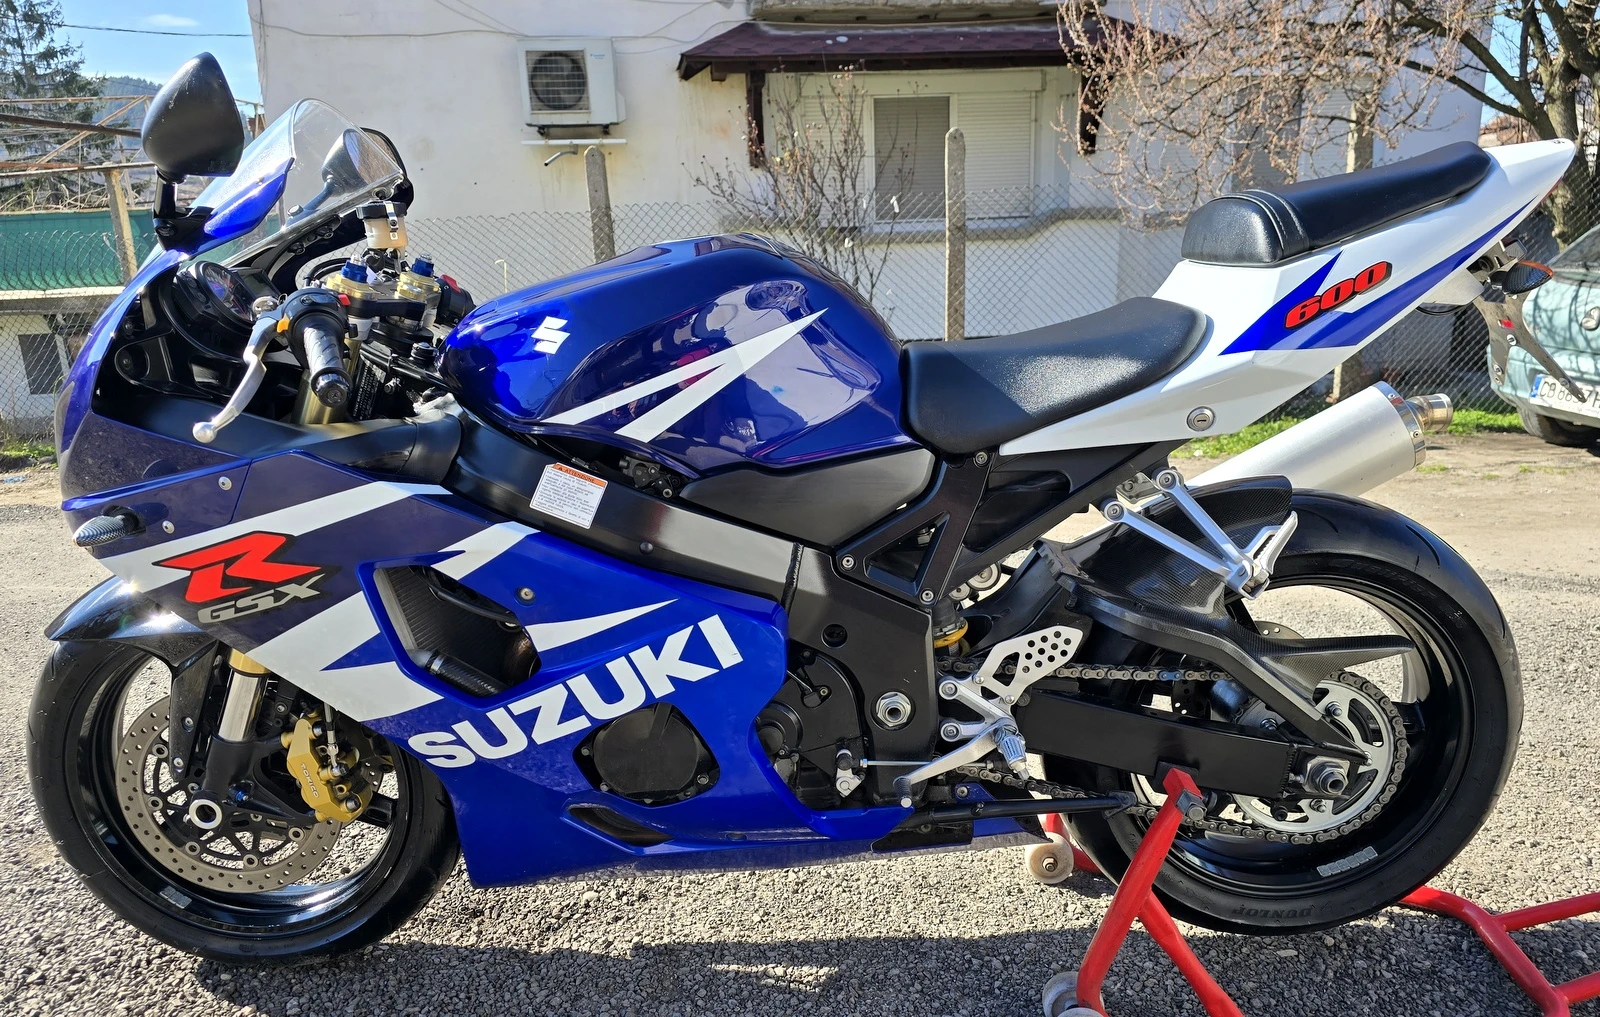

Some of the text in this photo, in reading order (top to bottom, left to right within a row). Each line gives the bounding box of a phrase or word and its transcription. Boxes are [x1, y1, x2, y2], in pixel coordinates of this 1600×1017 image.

[1284, 260, 1389, 329] 600
[1540, 381, 1557, 398] CB
[564, 468, 595, 483] ATTENZIONE
[156, 532, 322, 604] R
[197, 573, 326, 624] GSX
[408, 614, 744, 768] SUZUKI
[300, 762, 319, 798] TOKICO
[1231, 906, 1312, 919] DUNLOP
